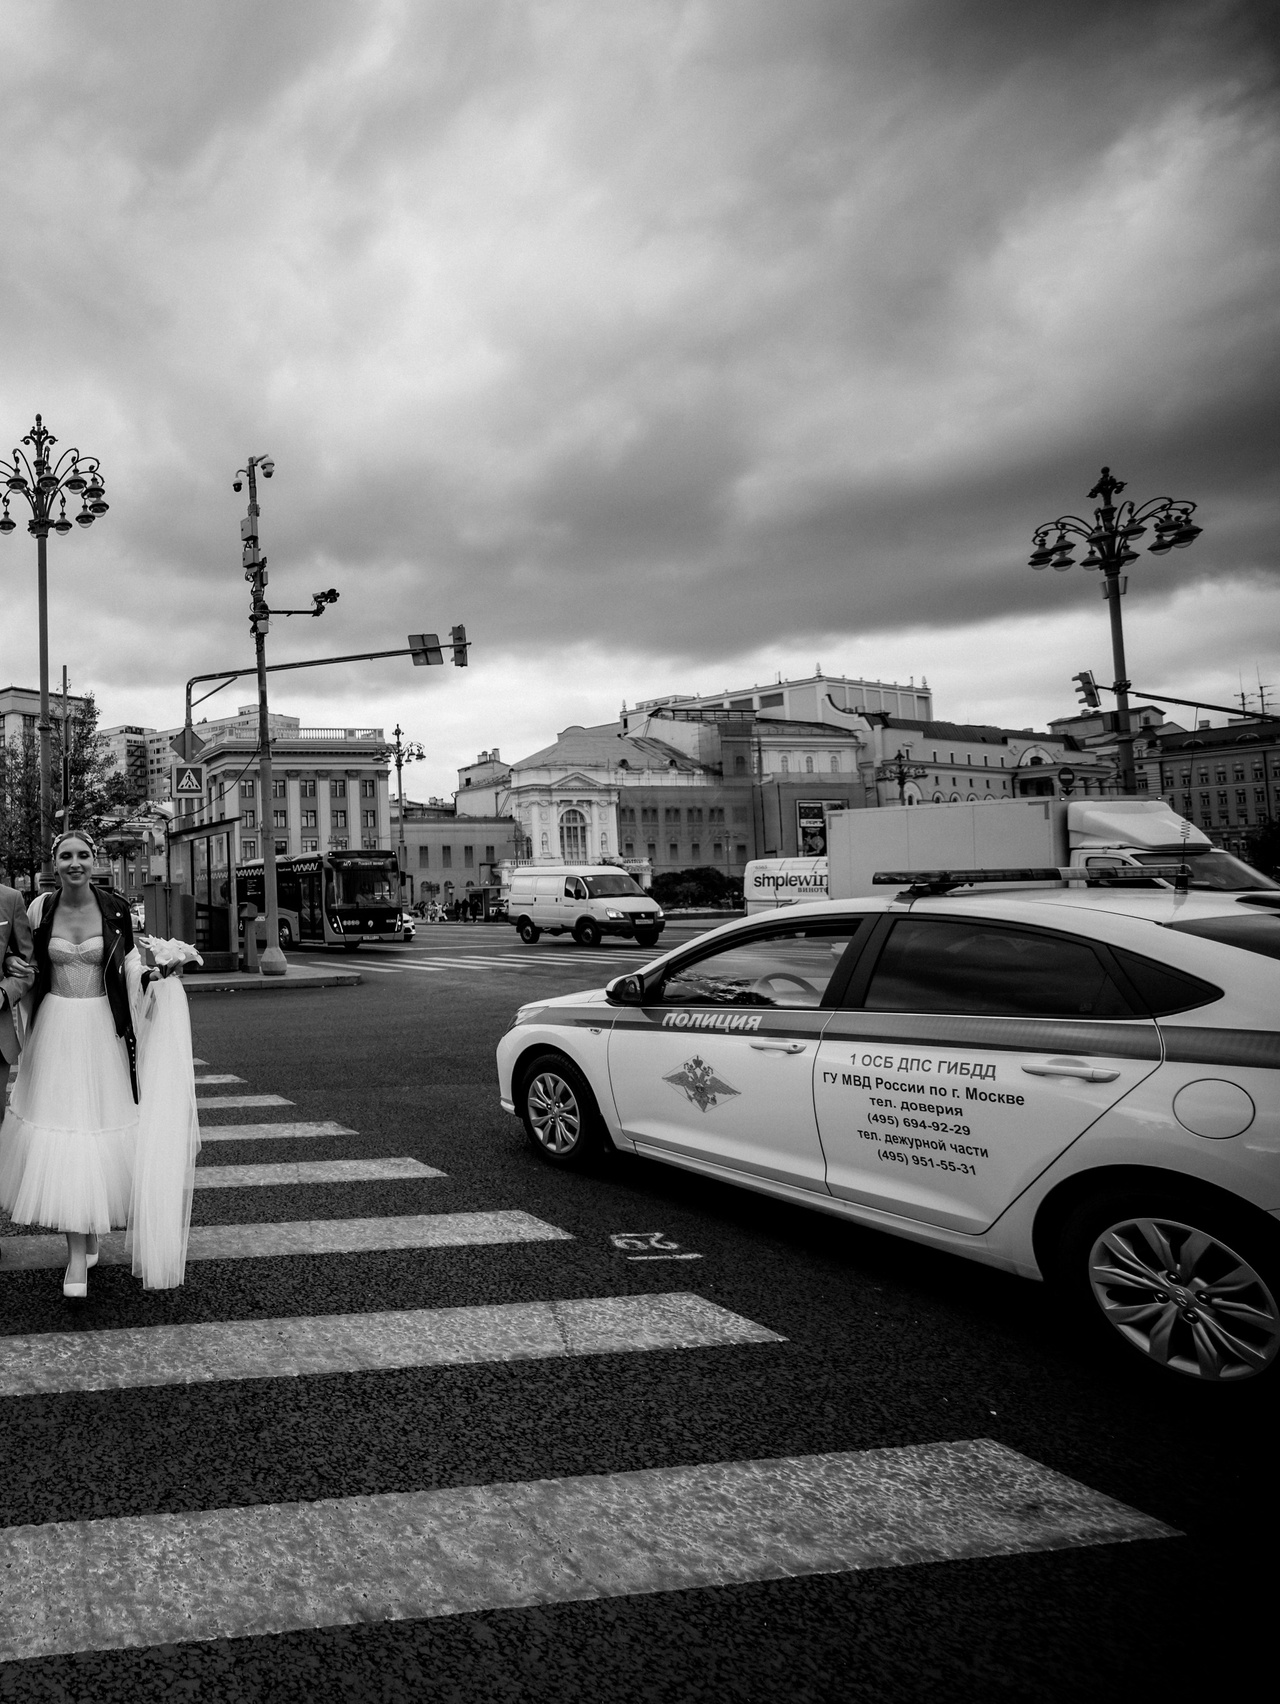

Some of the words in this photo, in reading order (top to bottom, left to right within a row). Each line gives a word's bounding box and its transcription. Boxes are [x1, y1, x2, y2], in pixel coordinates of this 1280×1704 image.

[662, 1013, 763, 1033] ПОЛИЦИЯ
[850, 1053, 857, 1065] 1
[861, 1055, 894, 1069] ОСБ
[897, 1058, 933, 1073] ДПС
[937, 1061, 997, 1080] ГИБДД
[823, 1071, 838, 1084] ГУ
[842, 1073, 872, 1090] МВД
[875, 1077, 925, 1094] России
[929, 1085, 948, 1097] по
[951, 1088, 960, 1099] г.
[965, 1086, 1025, 1106] Москве
[869, 1096, 897, 1109] тел.
[900, 1099, 964, 1117] доверия
[867, 1112, 900, 1128] (495)
[903, 1117, 971, 1136] 694-92-29
[857, 1129, 882, 1141] тел.
[884, 1133, 947, 1151] дежурной
[949, 1141, 989, 1159] части
[877, 1149, 910, 1166] (495)
[911, 1155, 977, 1176] 951-55-31
